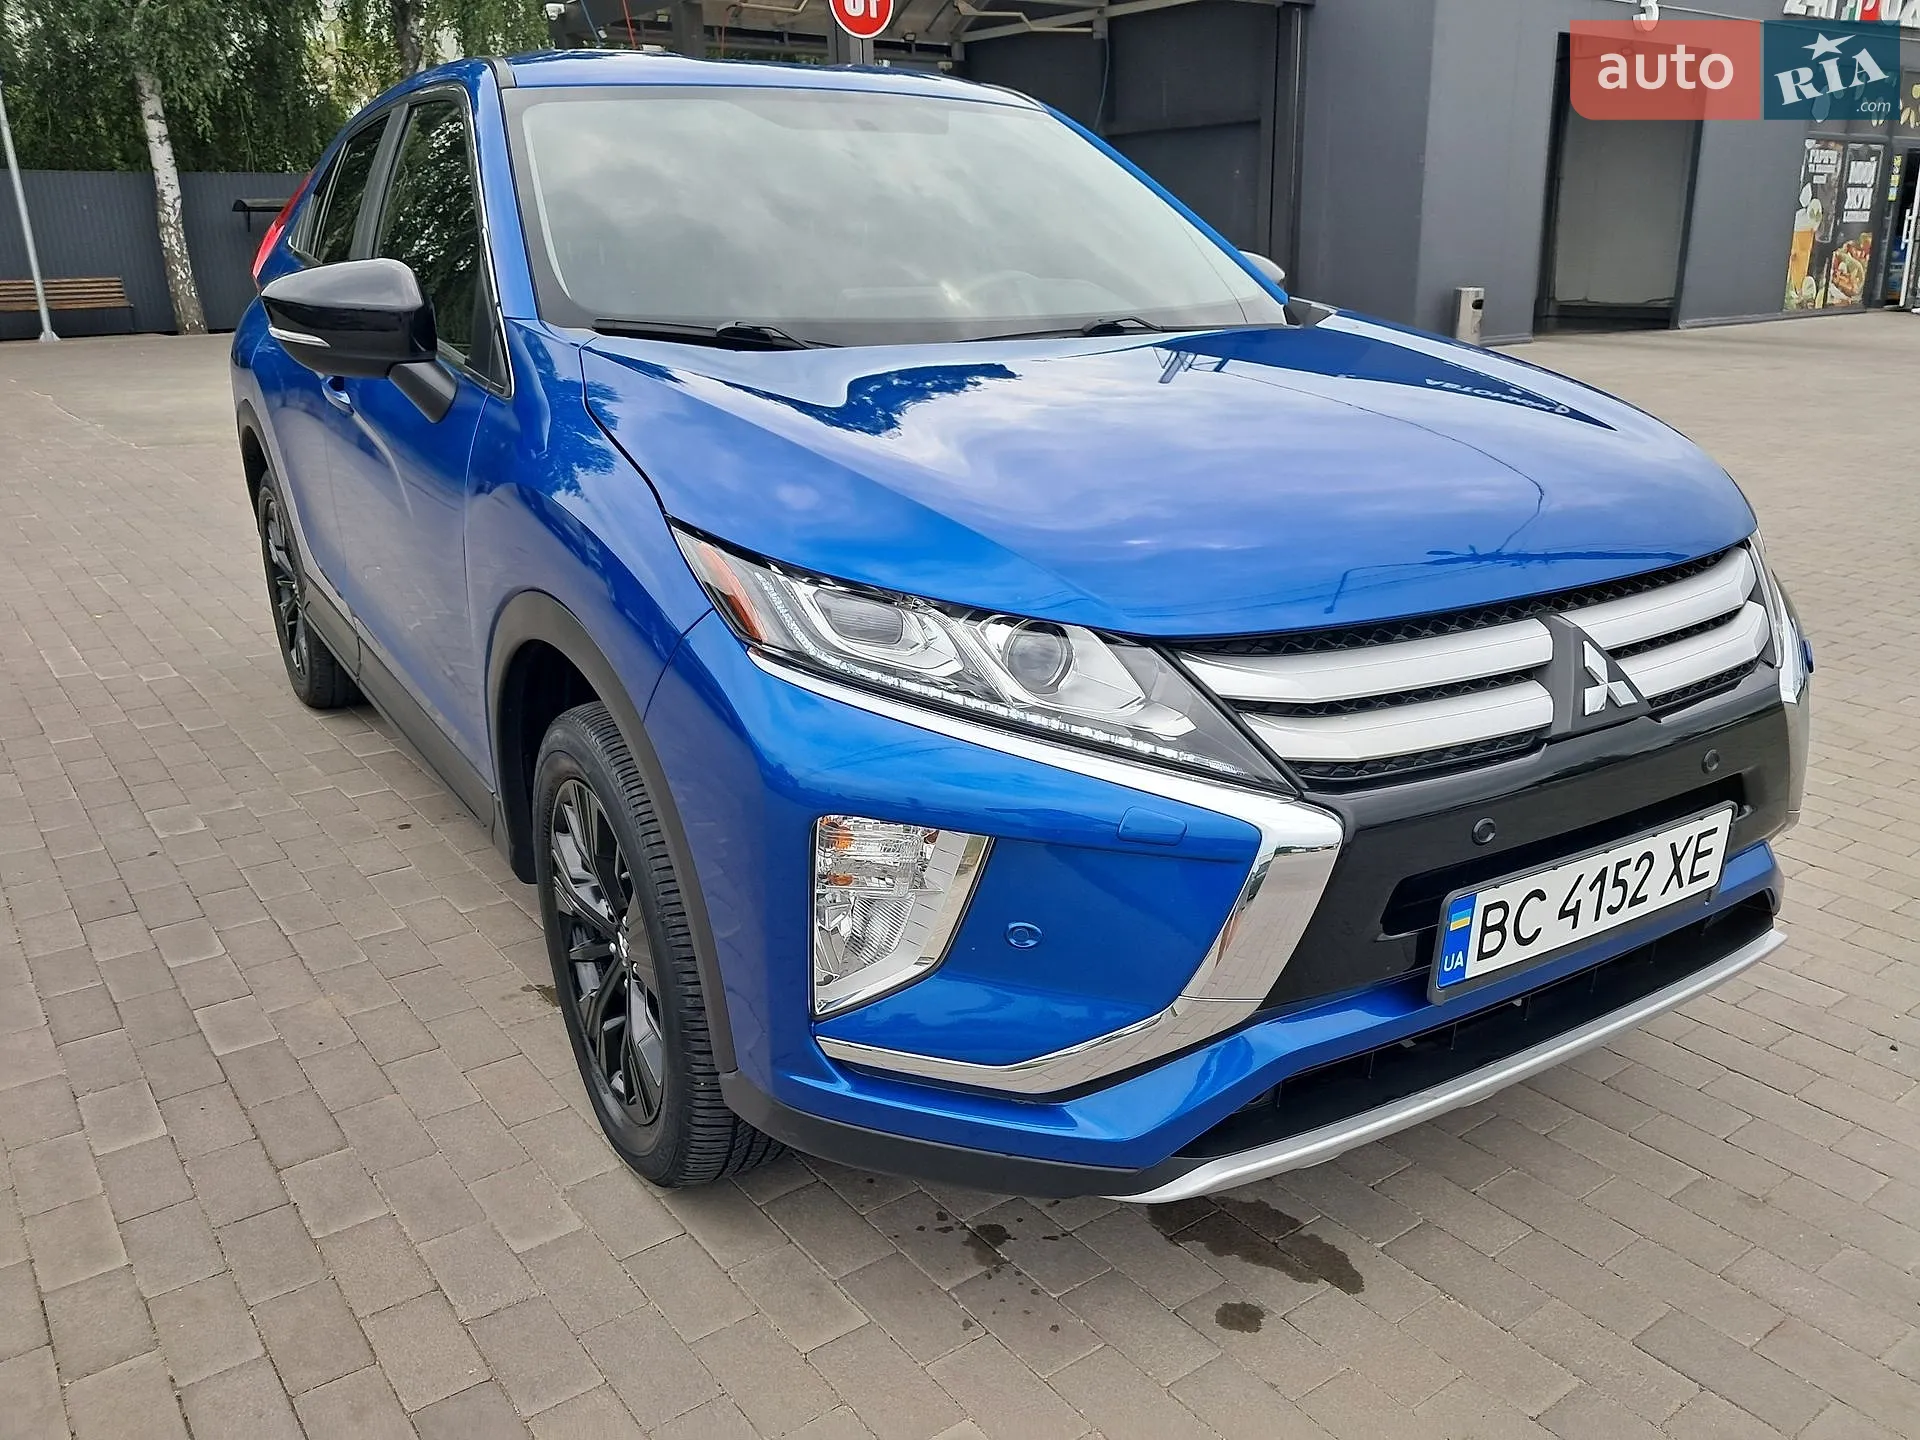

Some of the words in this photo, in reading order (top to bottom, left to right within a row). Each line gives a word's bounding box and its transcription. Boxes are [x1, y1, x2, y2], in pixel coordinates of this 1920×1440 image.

[1476, 888, 1547, 962] BC
[1557, 850, 1655, 930] 4152
[1660, 826, 1718, 896] XE
[1443, 950, 1465, 972] UA
